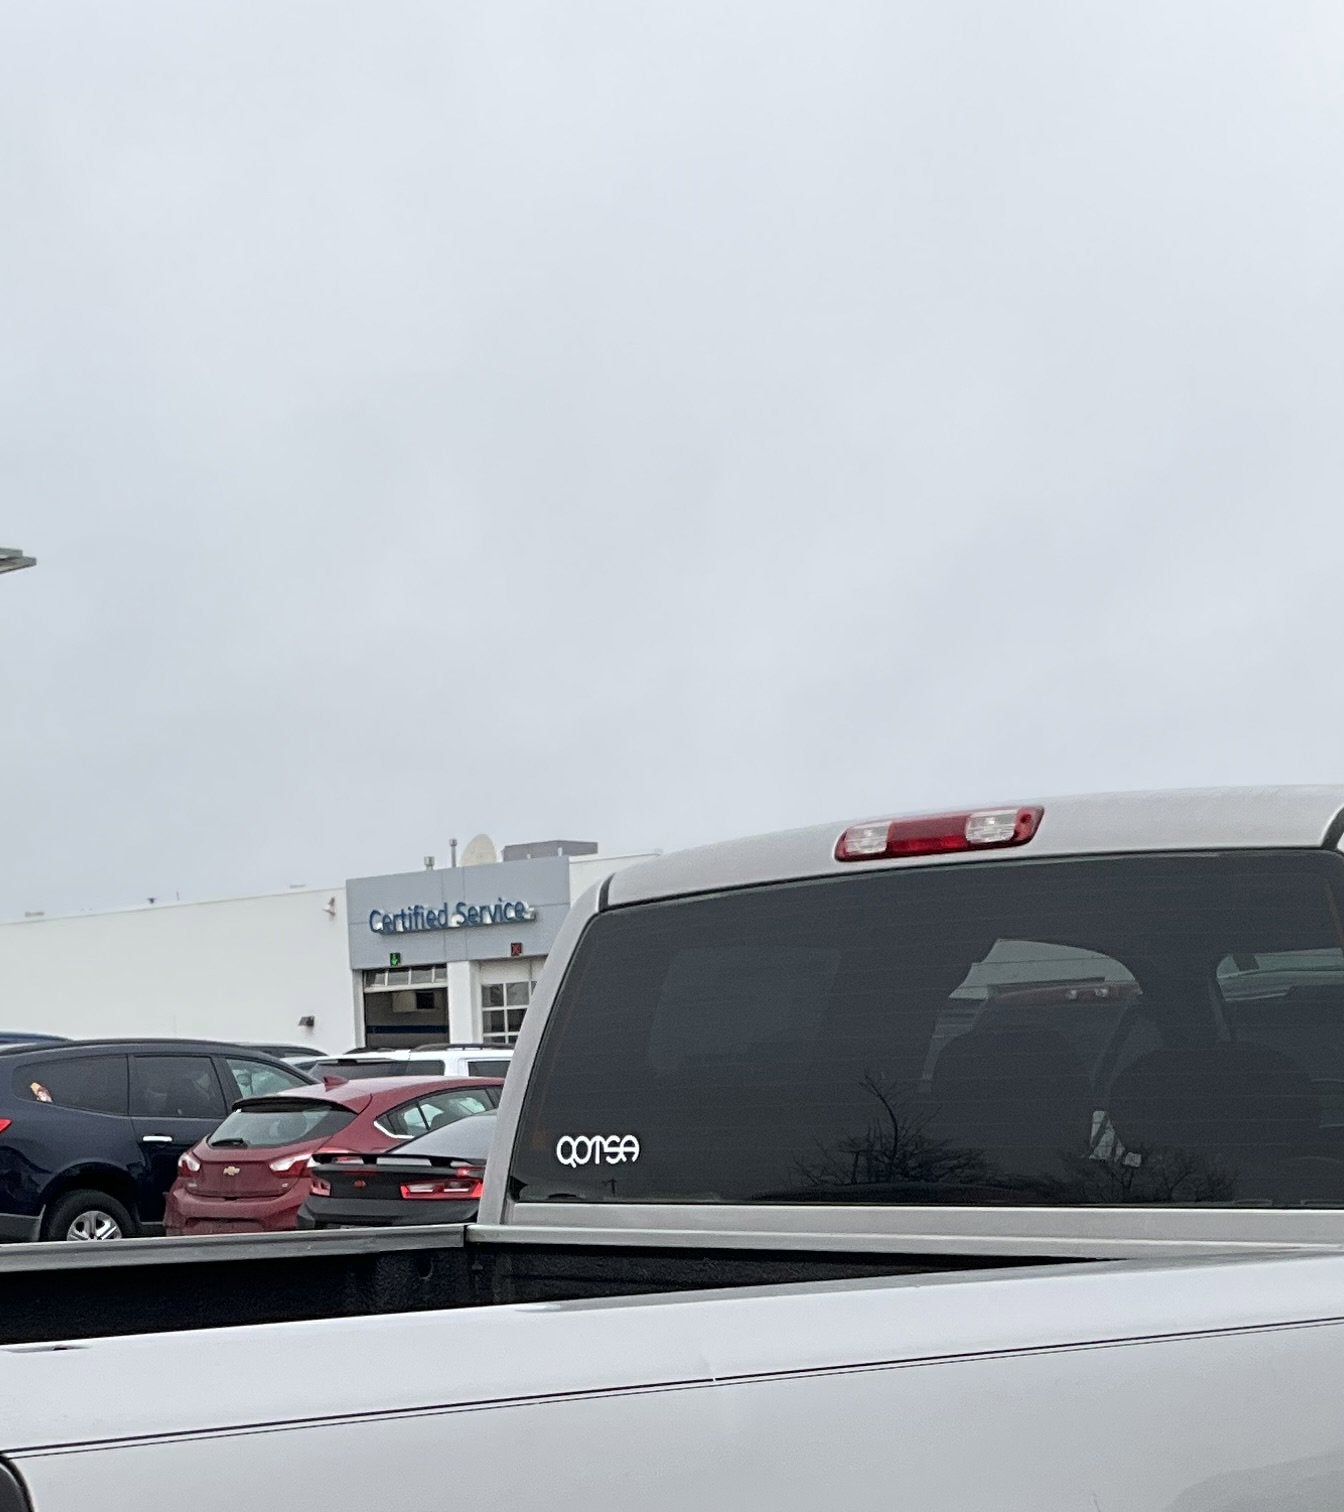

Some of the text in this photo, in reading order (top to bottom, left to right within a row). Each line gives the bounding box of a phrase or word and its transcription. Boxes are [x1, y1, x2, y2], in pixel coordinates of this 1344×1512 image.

[369, 897, 530, 935] Certified Service
[556, 1134, 640, 1168] QOTSA
